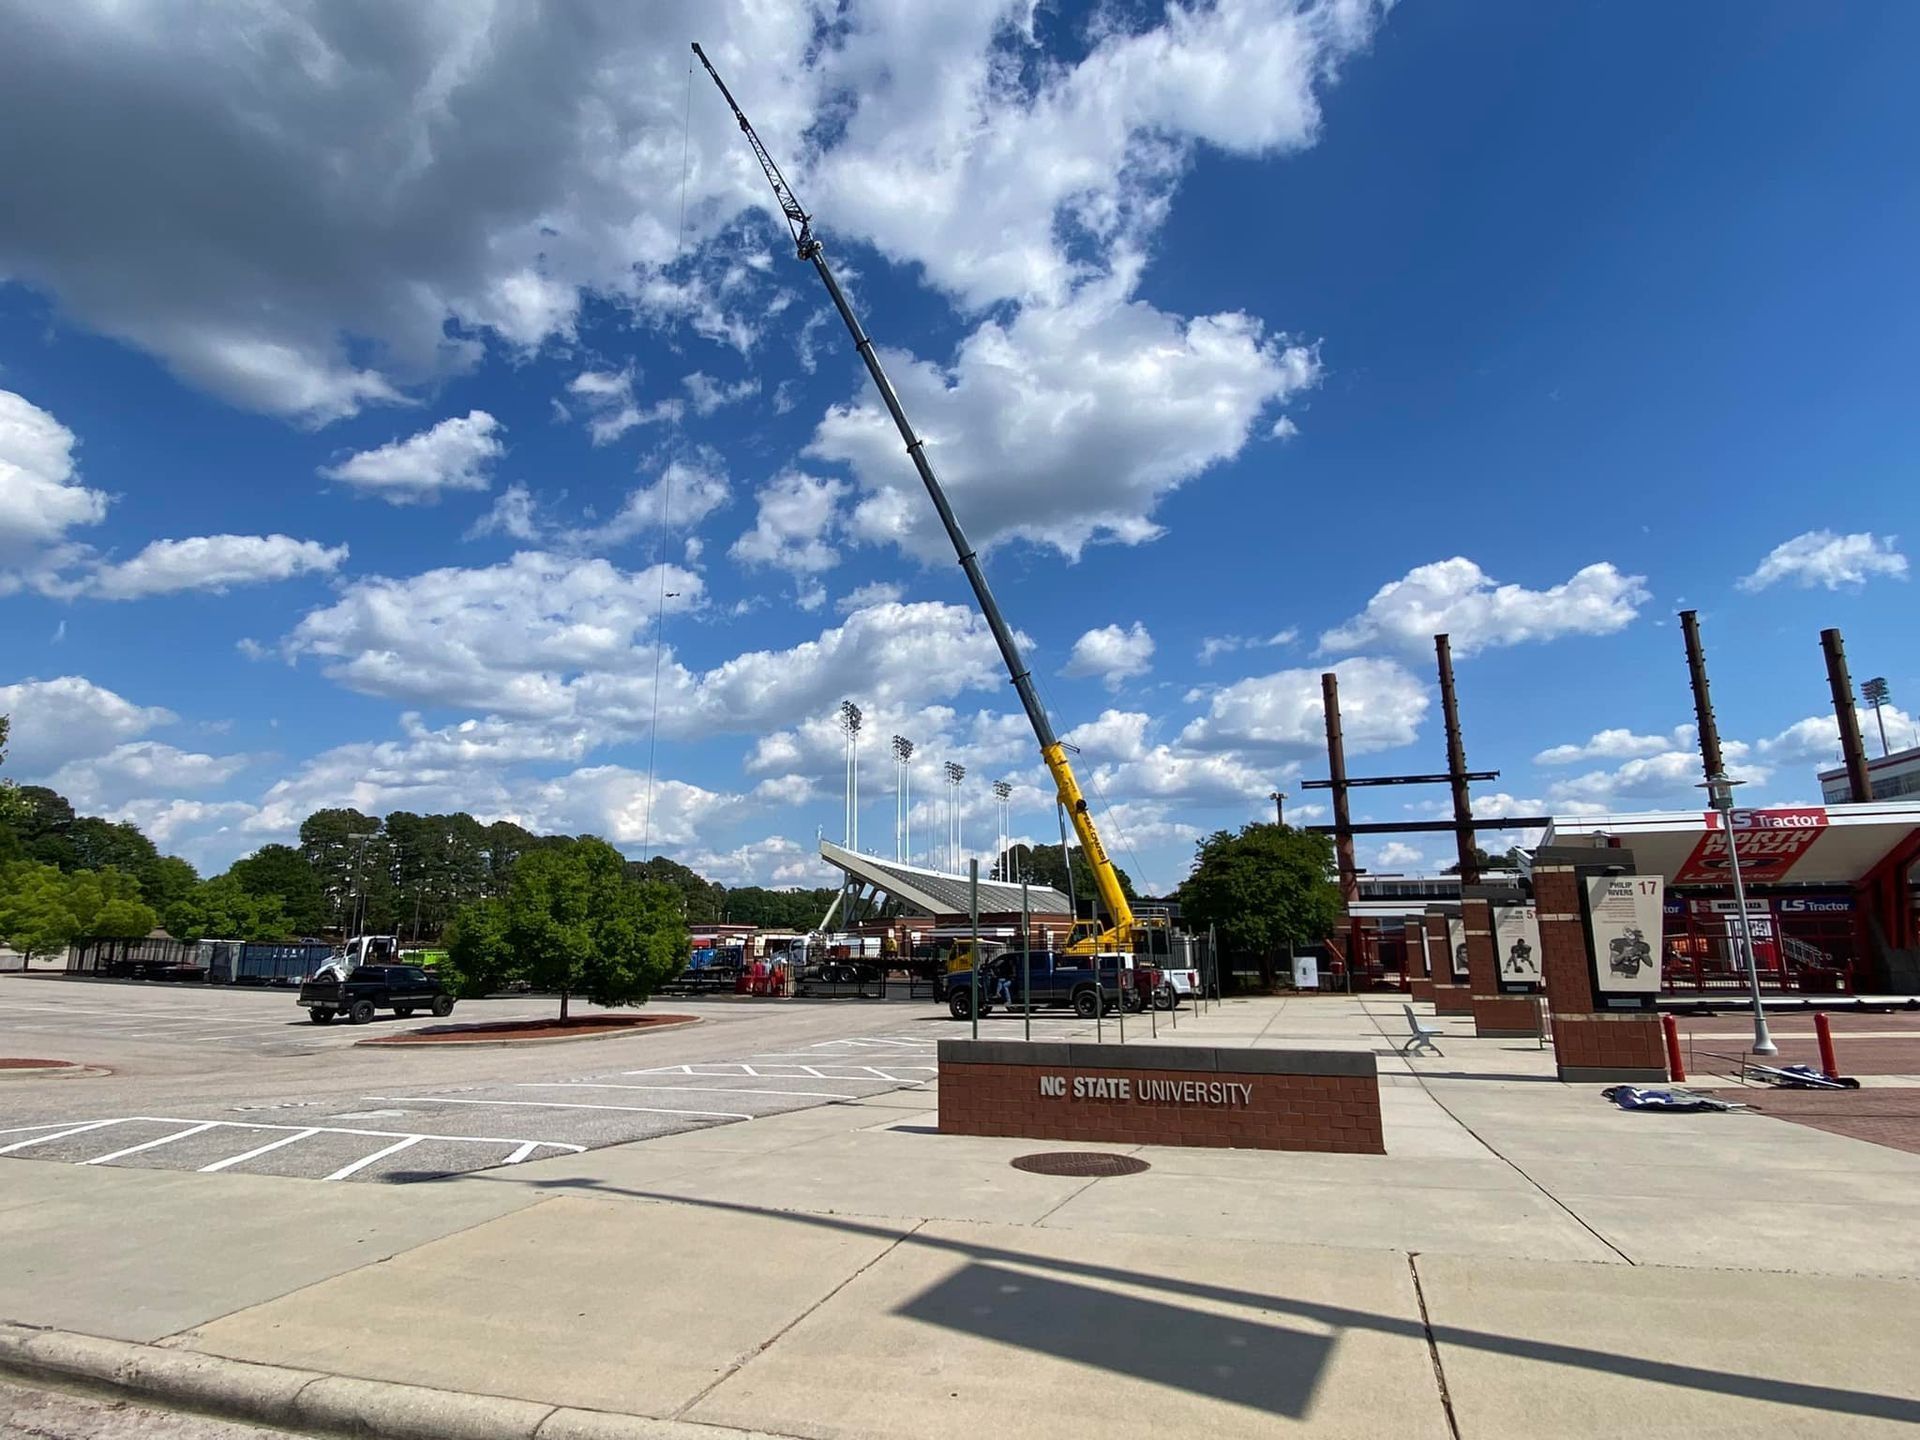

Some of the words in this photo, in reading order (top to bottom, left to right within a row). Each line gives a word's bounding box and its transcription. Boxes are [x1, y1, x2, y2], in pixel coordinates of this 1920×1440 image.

[1755, 815, 1819, 828] Tractor
[1706, 830, 1816, 845] NORTH
[1702, 842, 1799, 856] PLAZA
[1609, 881, 1633, 889] PHILIP
[1638, 881, 1657, 896] 17
[1781, 899, 1805, 912] LS
[1806, 901, 1849, 912] Tractor
[1040, 1076, 1067, 1097] NC
[1073, 1076, 1131, 1099] STATE
[1138, 1079, 1253, 1105] UNIVERSITY
